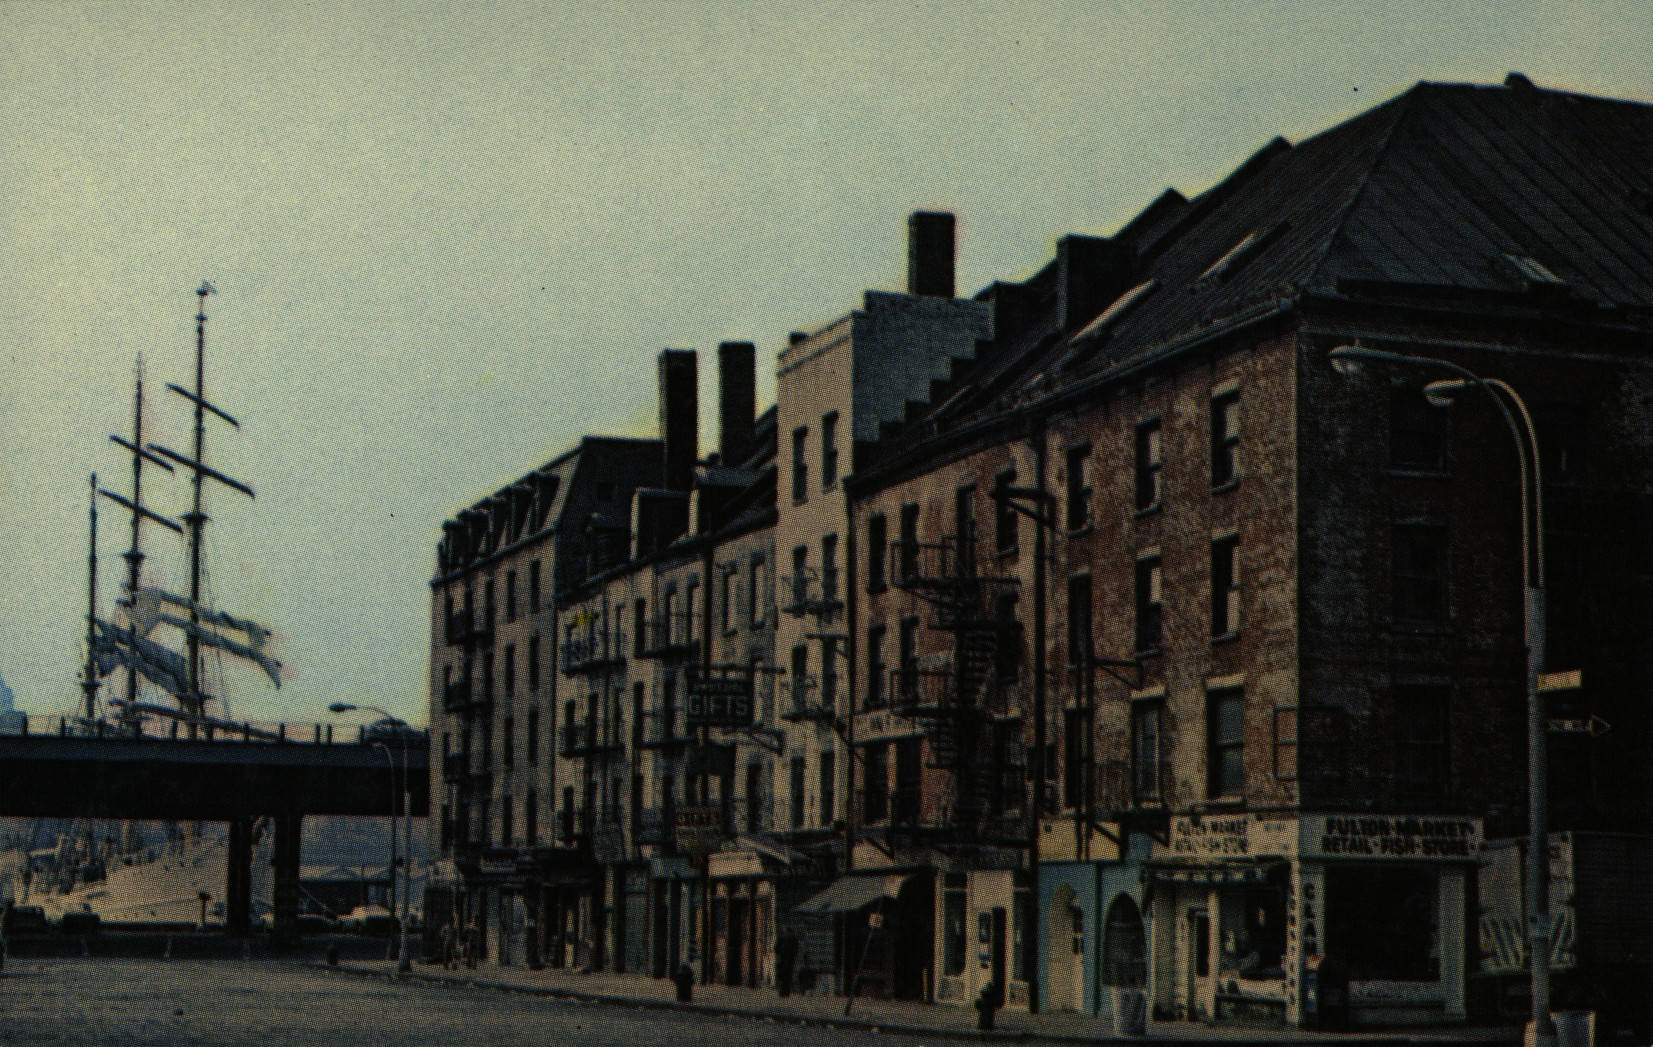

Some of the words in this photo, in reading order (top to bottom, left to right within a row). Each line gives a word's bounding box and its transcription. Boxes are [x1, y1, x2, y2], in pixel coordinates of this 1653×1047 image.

[688, 695, 749, 716] GIFTS
[1326, 817, 1390, 836] FULTON
[1322, 836, 1373, 855] RETAIL
[1381, 836, 1415, 855] FISH
[1423, 838, 1468, 856] STORE
